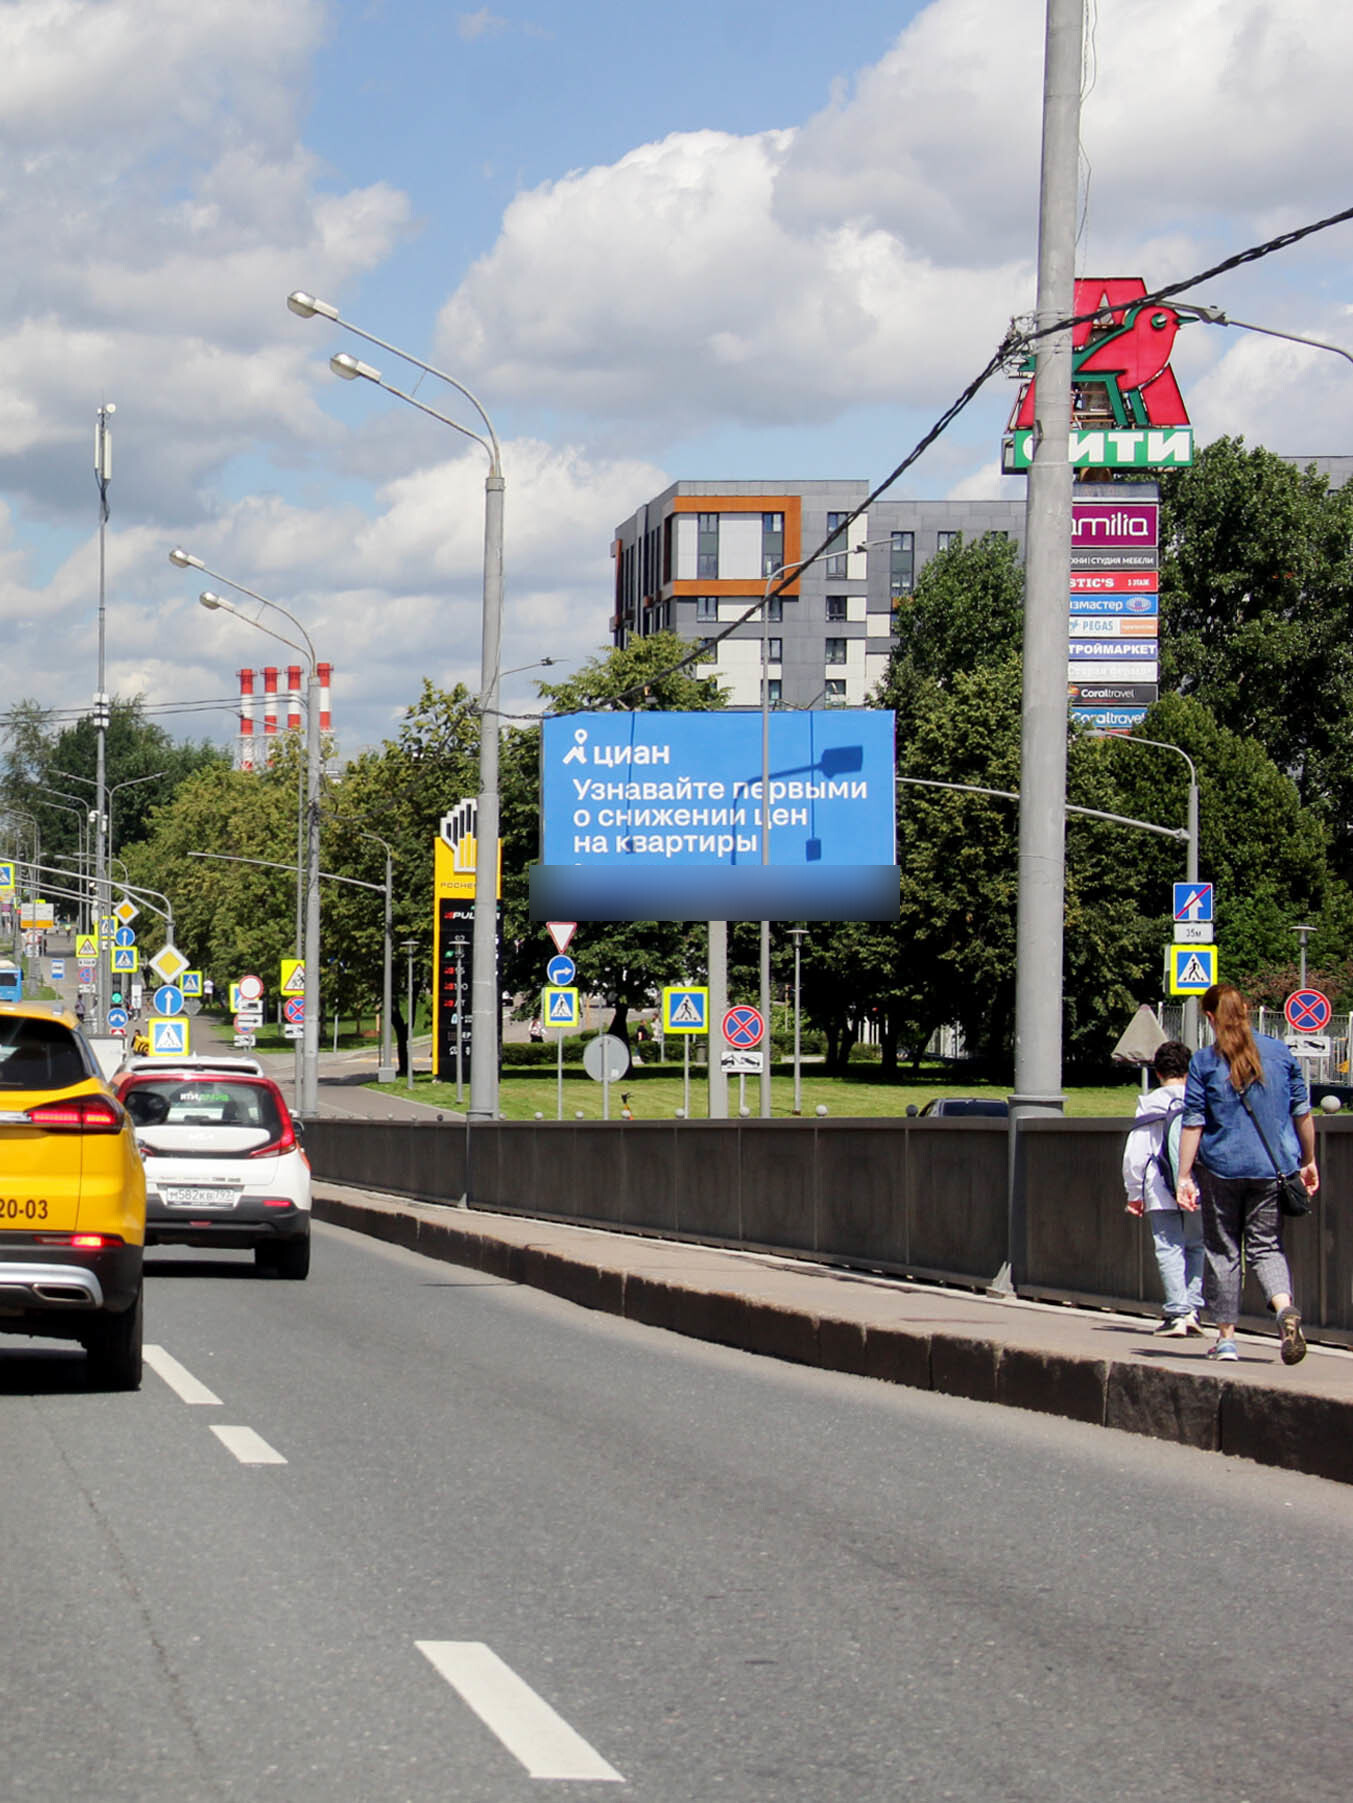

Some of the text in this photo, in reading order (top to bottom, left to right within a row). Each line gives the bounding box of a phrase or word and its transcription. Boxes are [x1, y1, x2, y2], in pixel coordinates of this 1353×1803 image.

[1082, 621, 1113, 631] PEGAS
[1069, 643, 1156, 654] ТРОЙМАРКЕТ
[1081, 689, 1135, 698] Coraltravel
[593, 745, 670, 768] циан
[572, 776, 867, 804] Узнавайте первыми
[573, 807, 807, 830] о снижении цен
[574, 834, 757, 858] на квартиры
